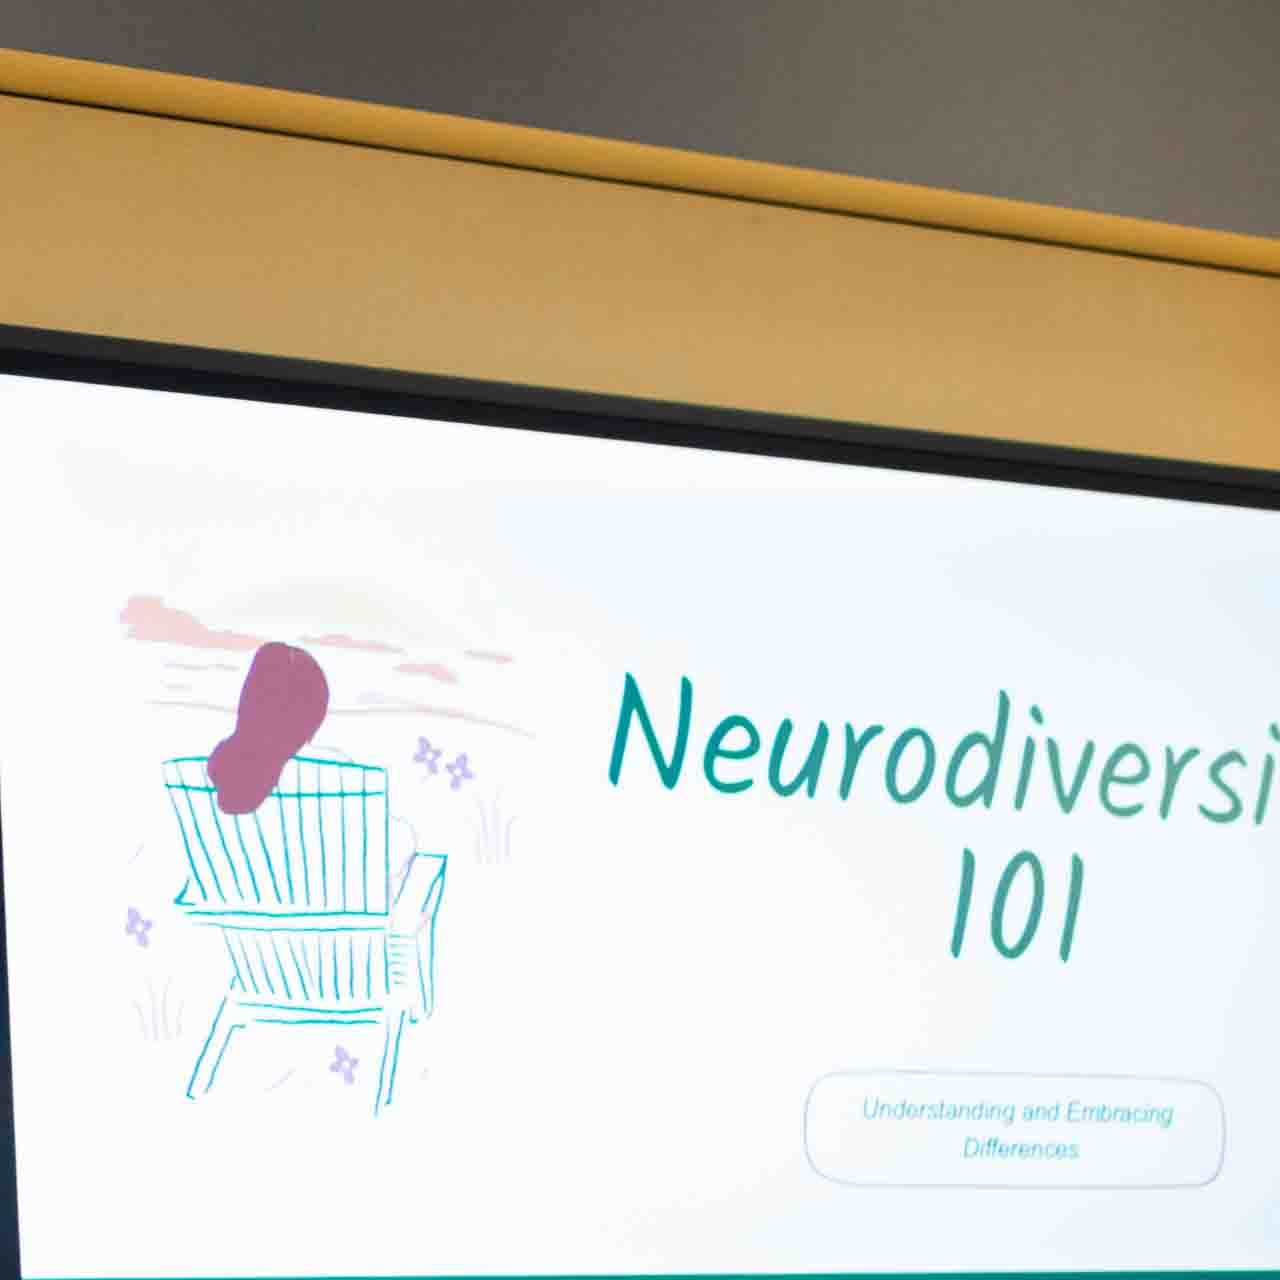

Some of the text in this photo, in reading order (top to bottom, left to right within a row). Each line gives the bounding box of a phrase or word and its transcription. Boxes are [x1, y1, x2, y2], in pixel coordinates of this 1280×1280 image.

[950, 847, 1084, 964] 101
[862, 1096, 1176, 1129] Understanding and Embracing
[963, 1135, 1081, 1160] Differences
